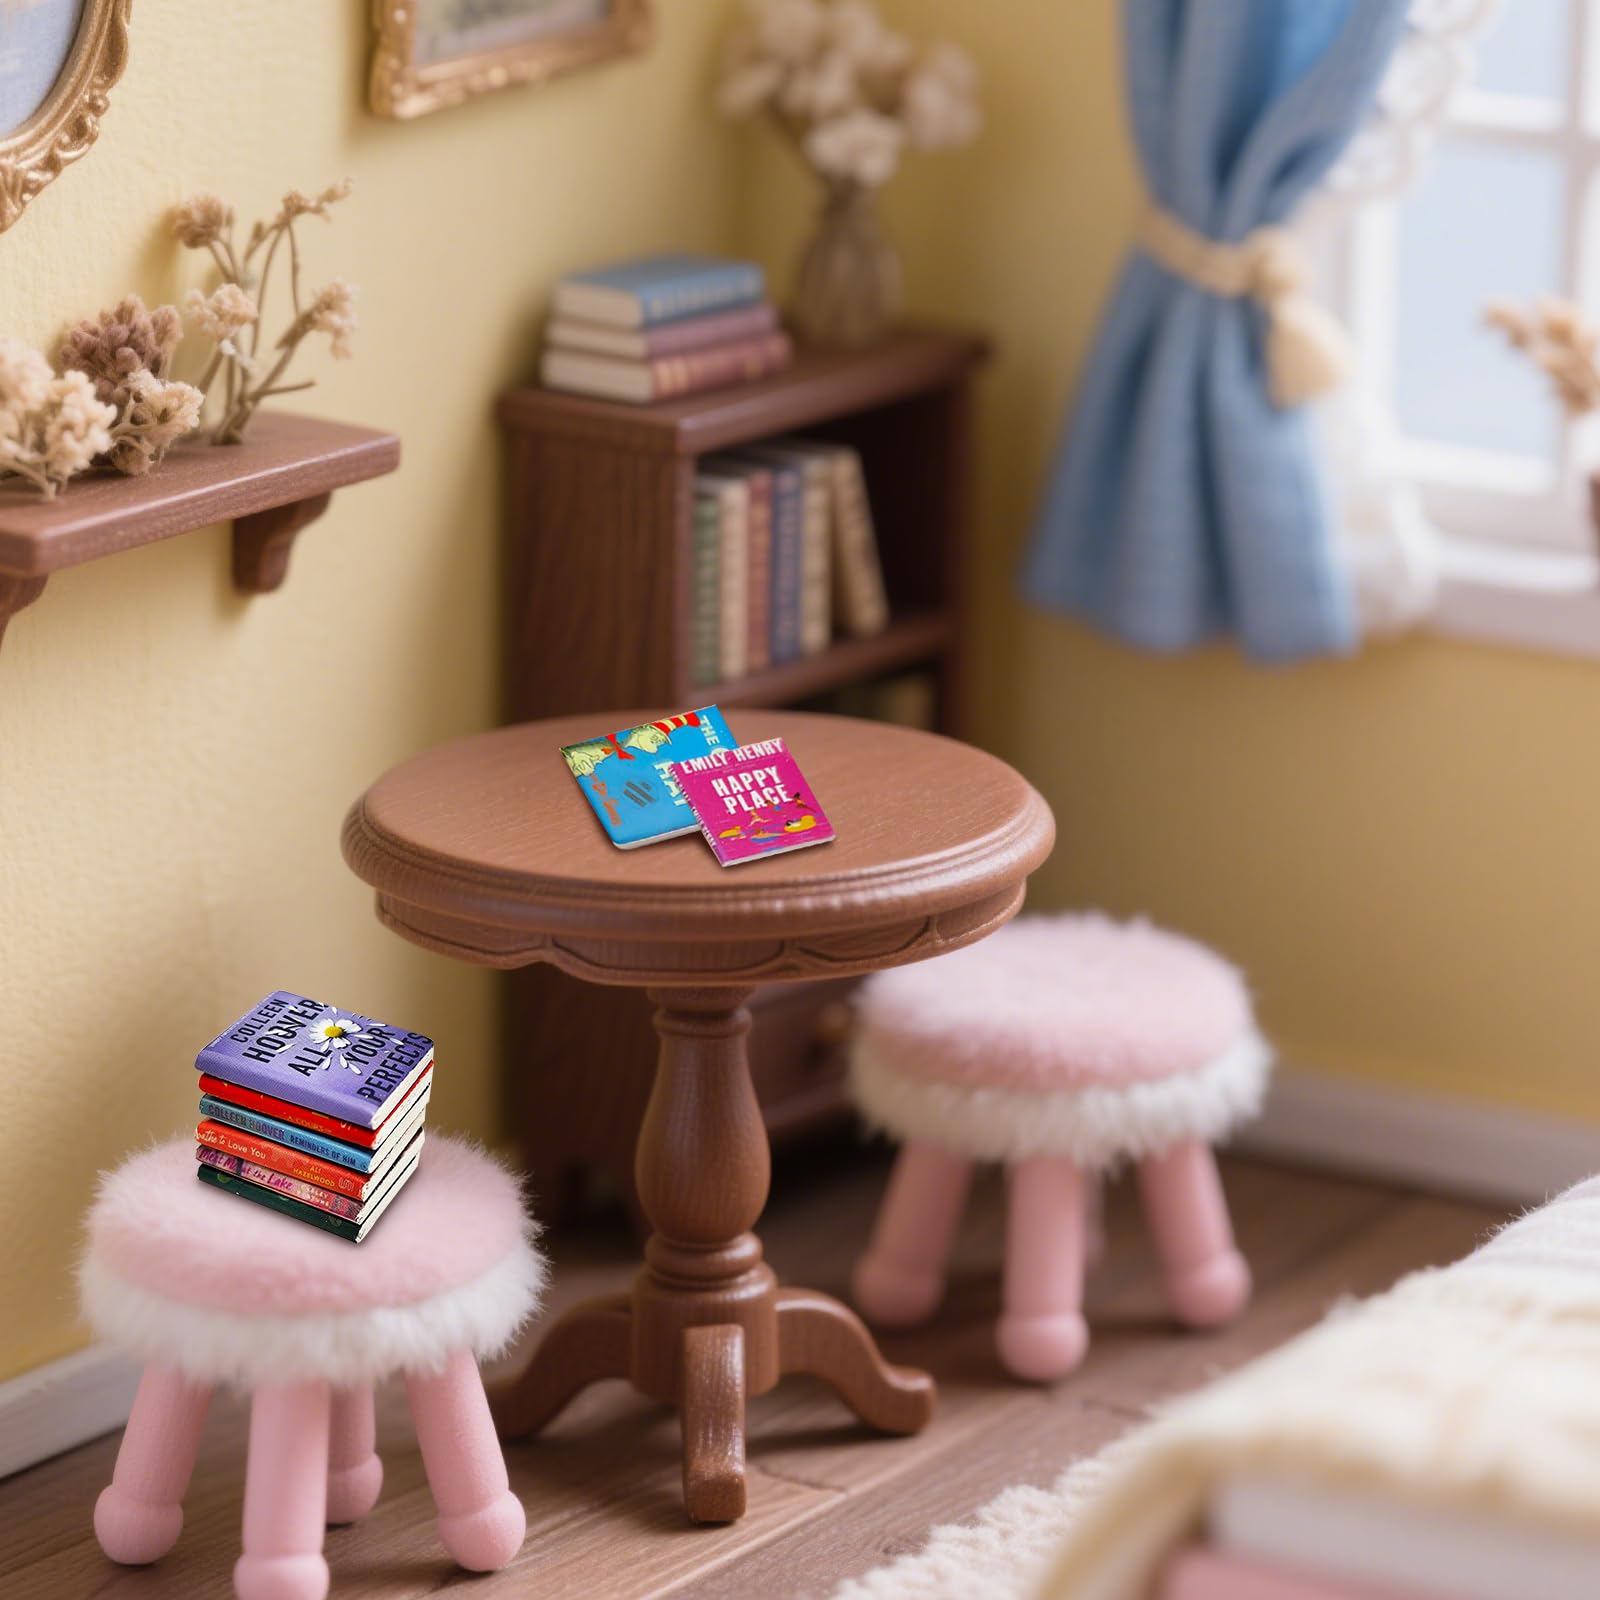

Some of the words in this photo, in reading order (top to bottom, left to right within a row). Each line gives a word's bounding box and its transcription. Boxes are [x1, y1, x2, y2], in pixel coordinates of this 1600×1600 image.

[700, 714, 721, 746] THE
[680, 751, 729, 775] EMILY
[733, 739, 784, 762] HENRY
[711, 766, 782, 797] HAPPY
[722, 784, 794, 815] PLACE
[230, 998, 289, 1043] COLLEEN
[241, 999, 329, 1064] HOOVER
[287, 1047, 334, 1077] ALL
[343, 1027, 396, 1066] YOUR
[356, 1032, 434, 1104] PERFECTS
[227, 1139, 248, 1154] Love
[250, 1146, 267, 1160] You
[290, 1134, 330, 1157] REMINDERS
[331, 1150, 342, 1160] OF
[267, 1172, 294, 1191] Lake
[293, 1167, 336, 1188] HAZELWOOD
